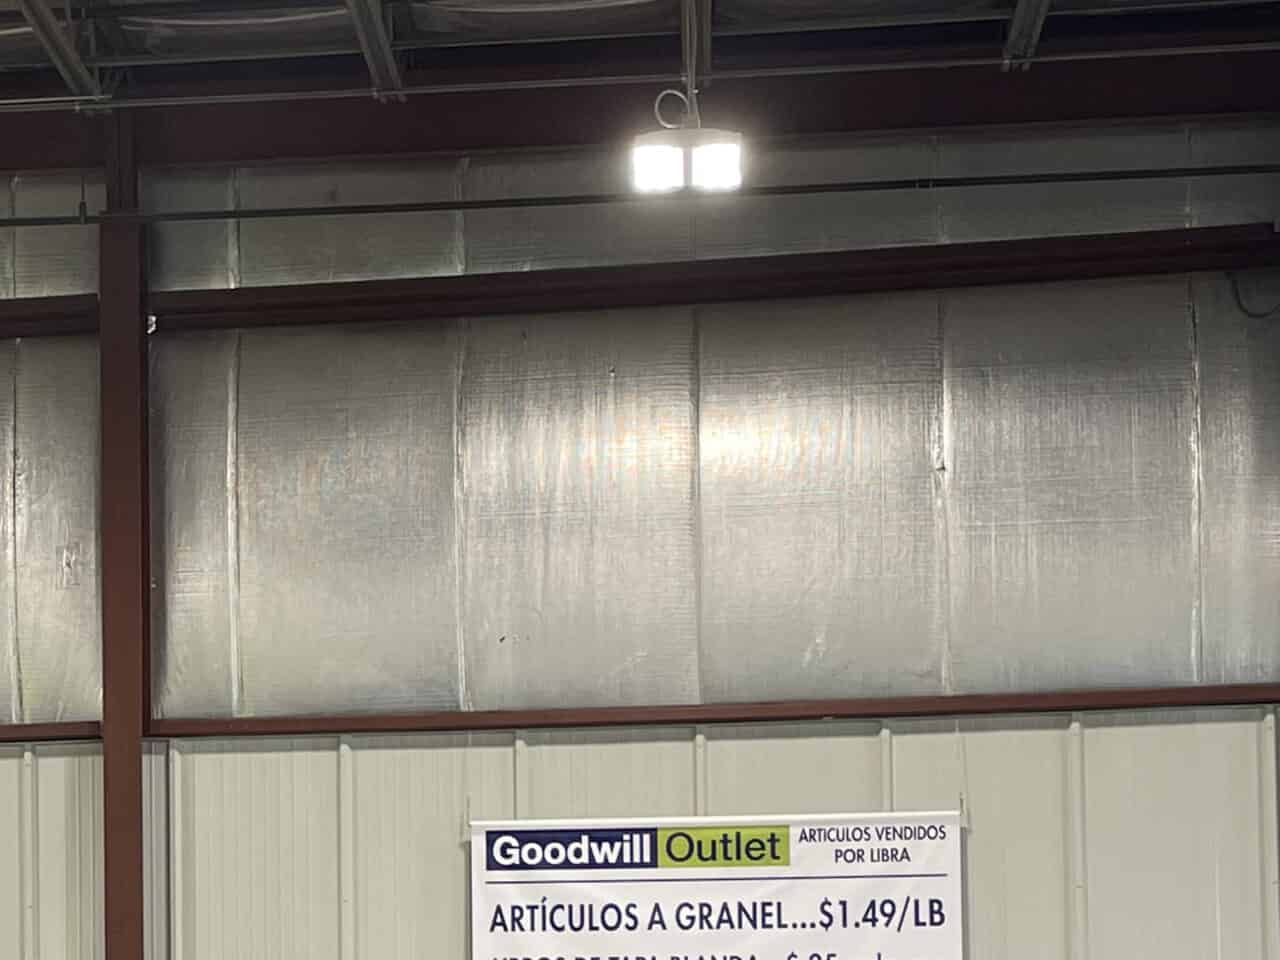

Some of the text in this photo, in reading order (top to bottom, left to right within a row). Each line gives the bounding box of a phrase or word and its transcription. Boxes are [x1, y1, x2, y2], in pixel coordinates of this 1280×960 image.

[875, 825, 946, 841] VENDIDOS
[493, 832, 780, 865] Goodwill Outlet
[835, 848, 910, 863] POR LIBRA
[490, 896, 638, 932] ARTÍCULOS
[648, 903, 666, 930] A
